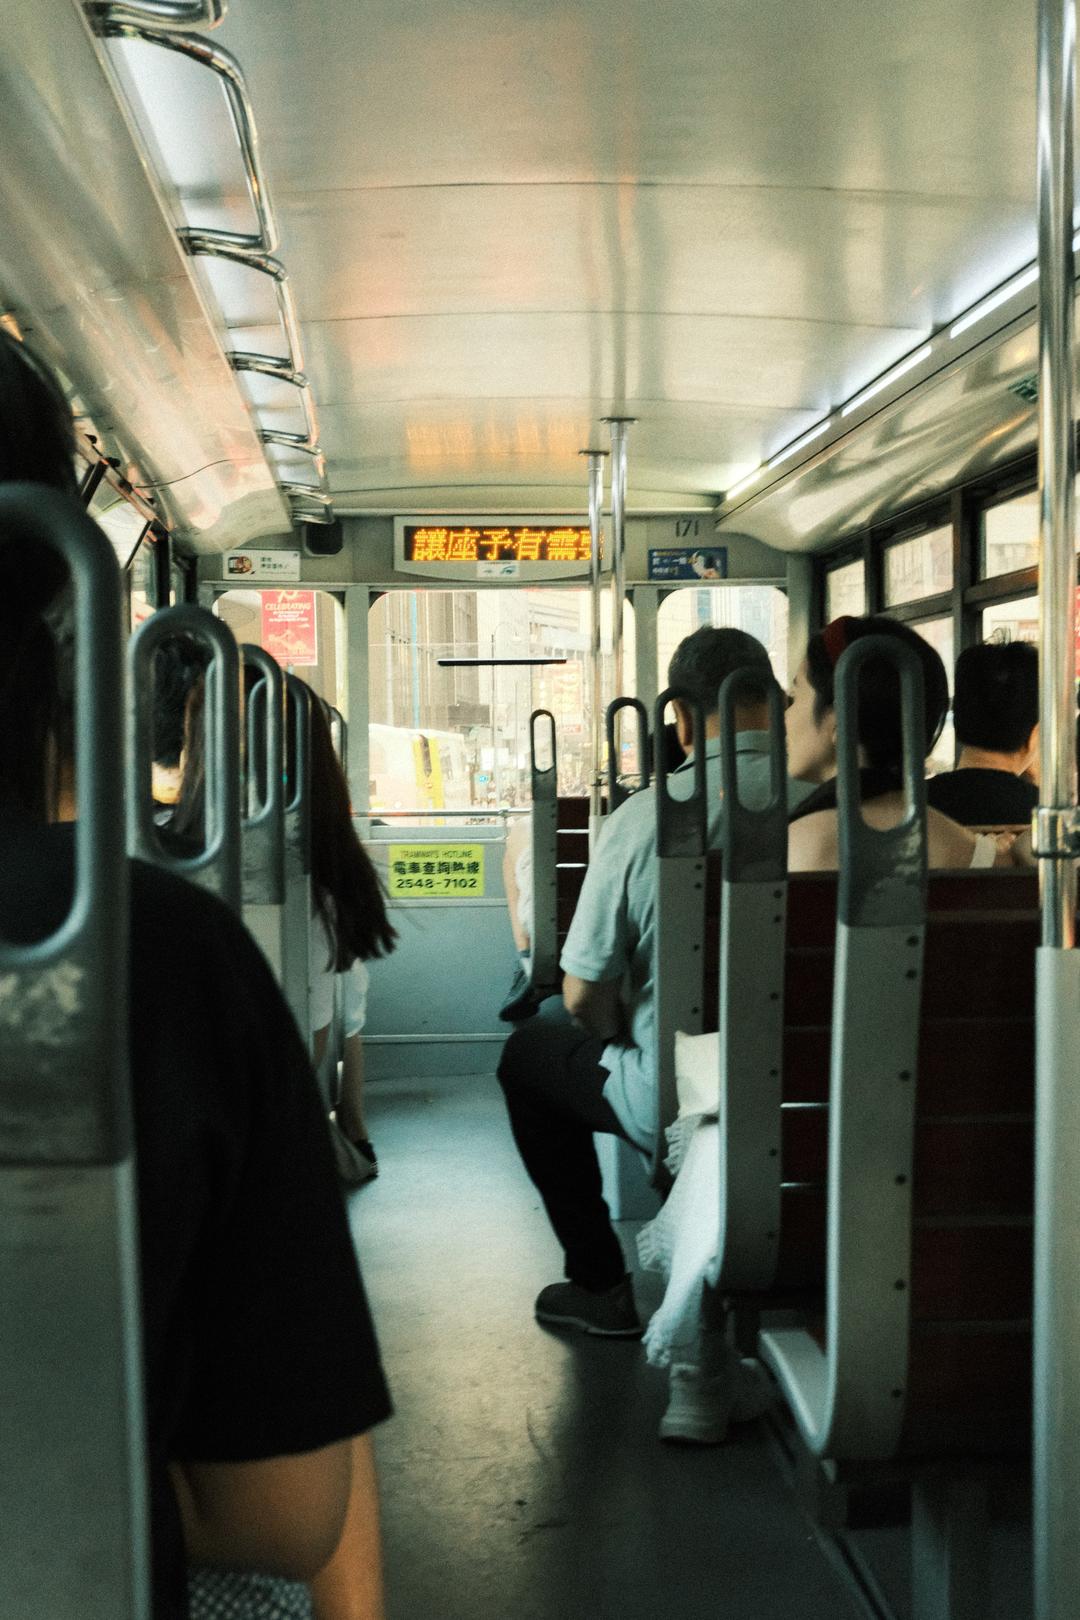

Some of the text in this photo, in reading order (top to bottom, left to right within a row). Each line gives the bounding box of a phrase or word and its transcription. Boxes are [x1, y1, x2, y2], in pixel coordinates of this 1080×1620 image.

[675, 519, 699, 537] 171
[265, 602, 311, 611] CELEBRATING
[392, 861, 480, 875] 電車查詢熱線
[395, 878, 478, 889] 2548-7102
